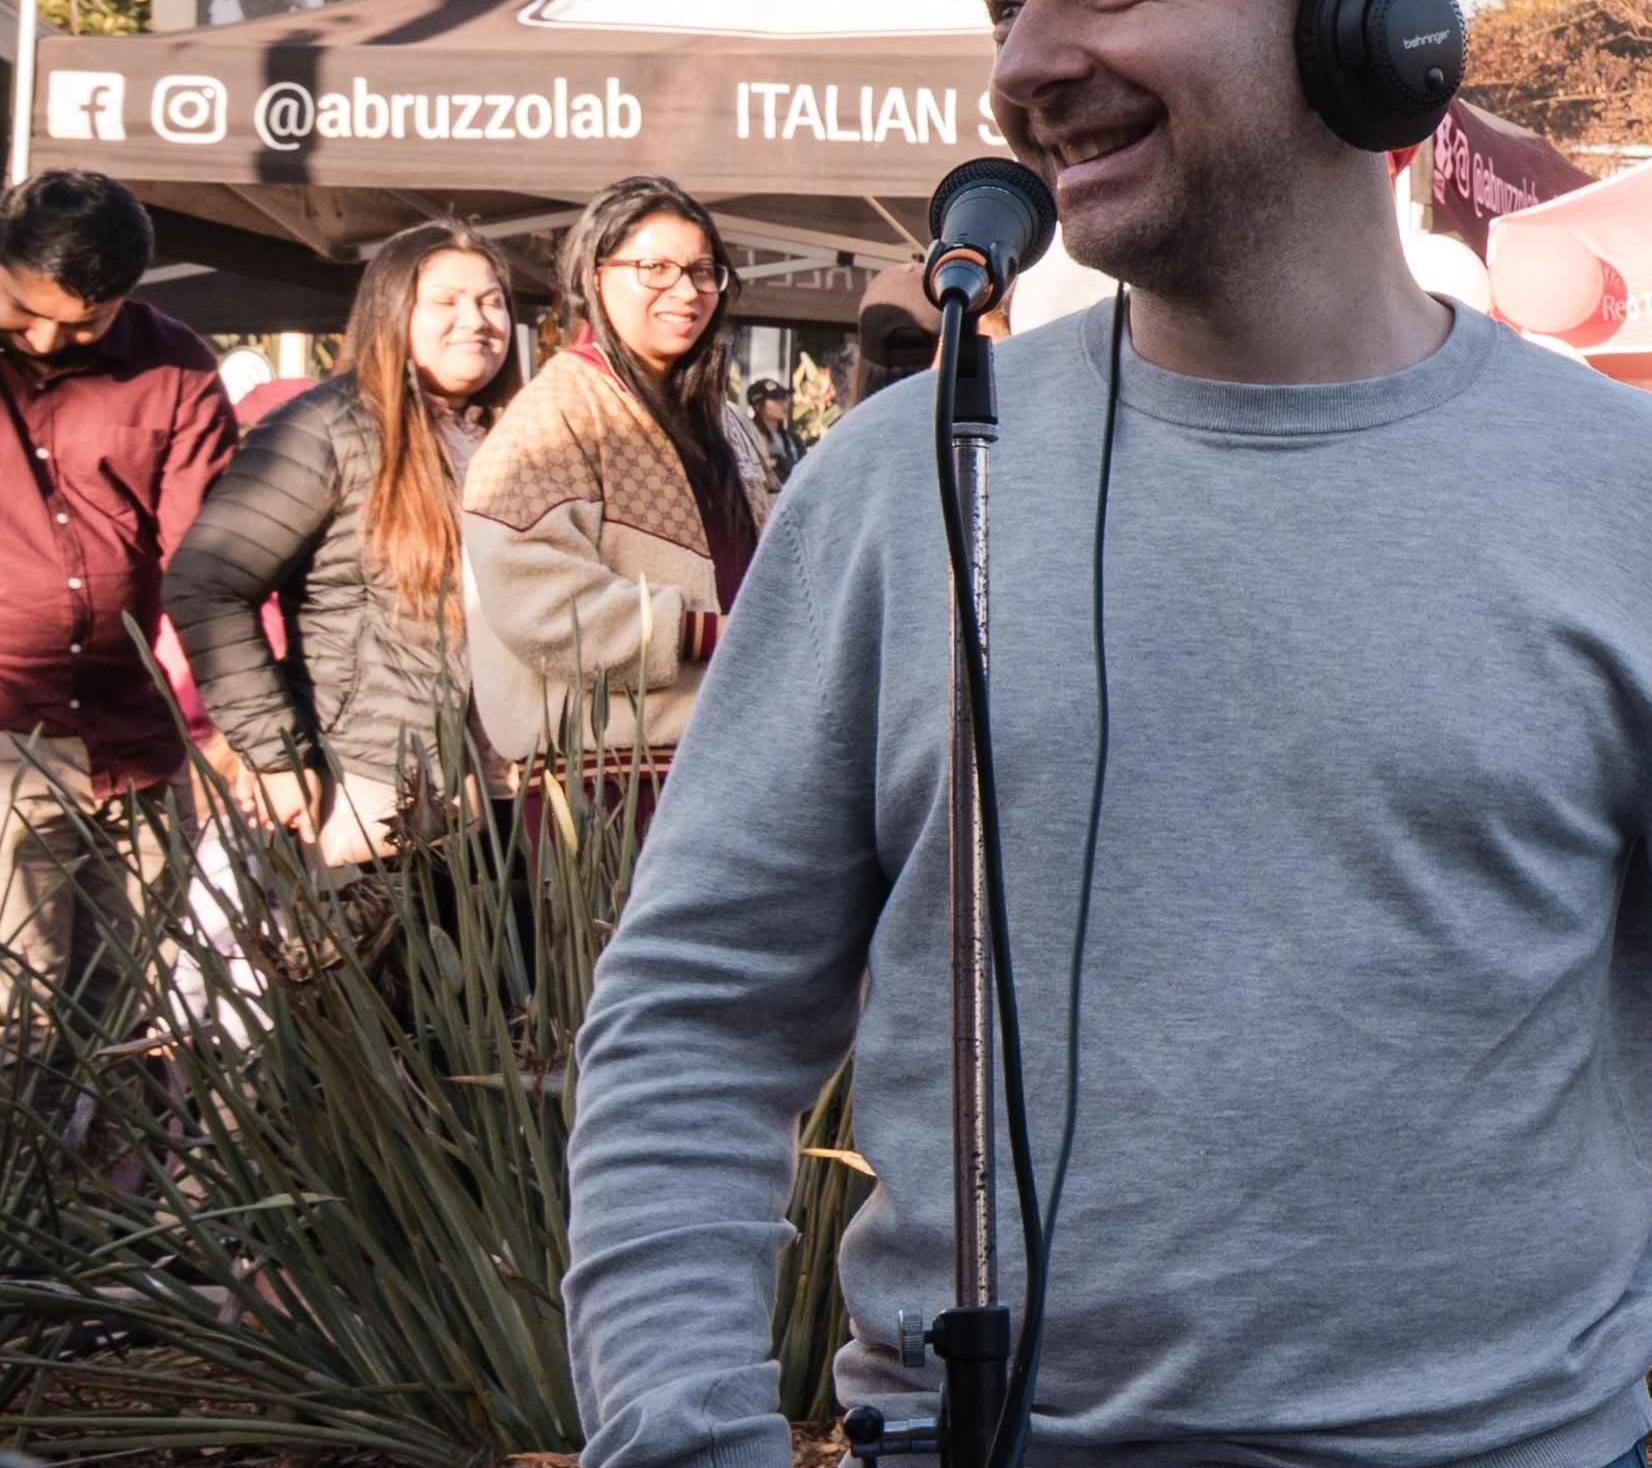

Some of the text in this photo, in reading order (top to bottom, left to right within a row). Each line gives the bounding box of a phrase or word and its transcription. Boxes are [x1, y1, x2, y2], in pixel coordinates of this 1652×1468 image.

[1402, 28, 1451, 50] behringer
[253, 76, 643, 151] @abruzzolab
[735, 81, 957, 144] ITALIAN
[1601, 292, 1640, 322] Red
